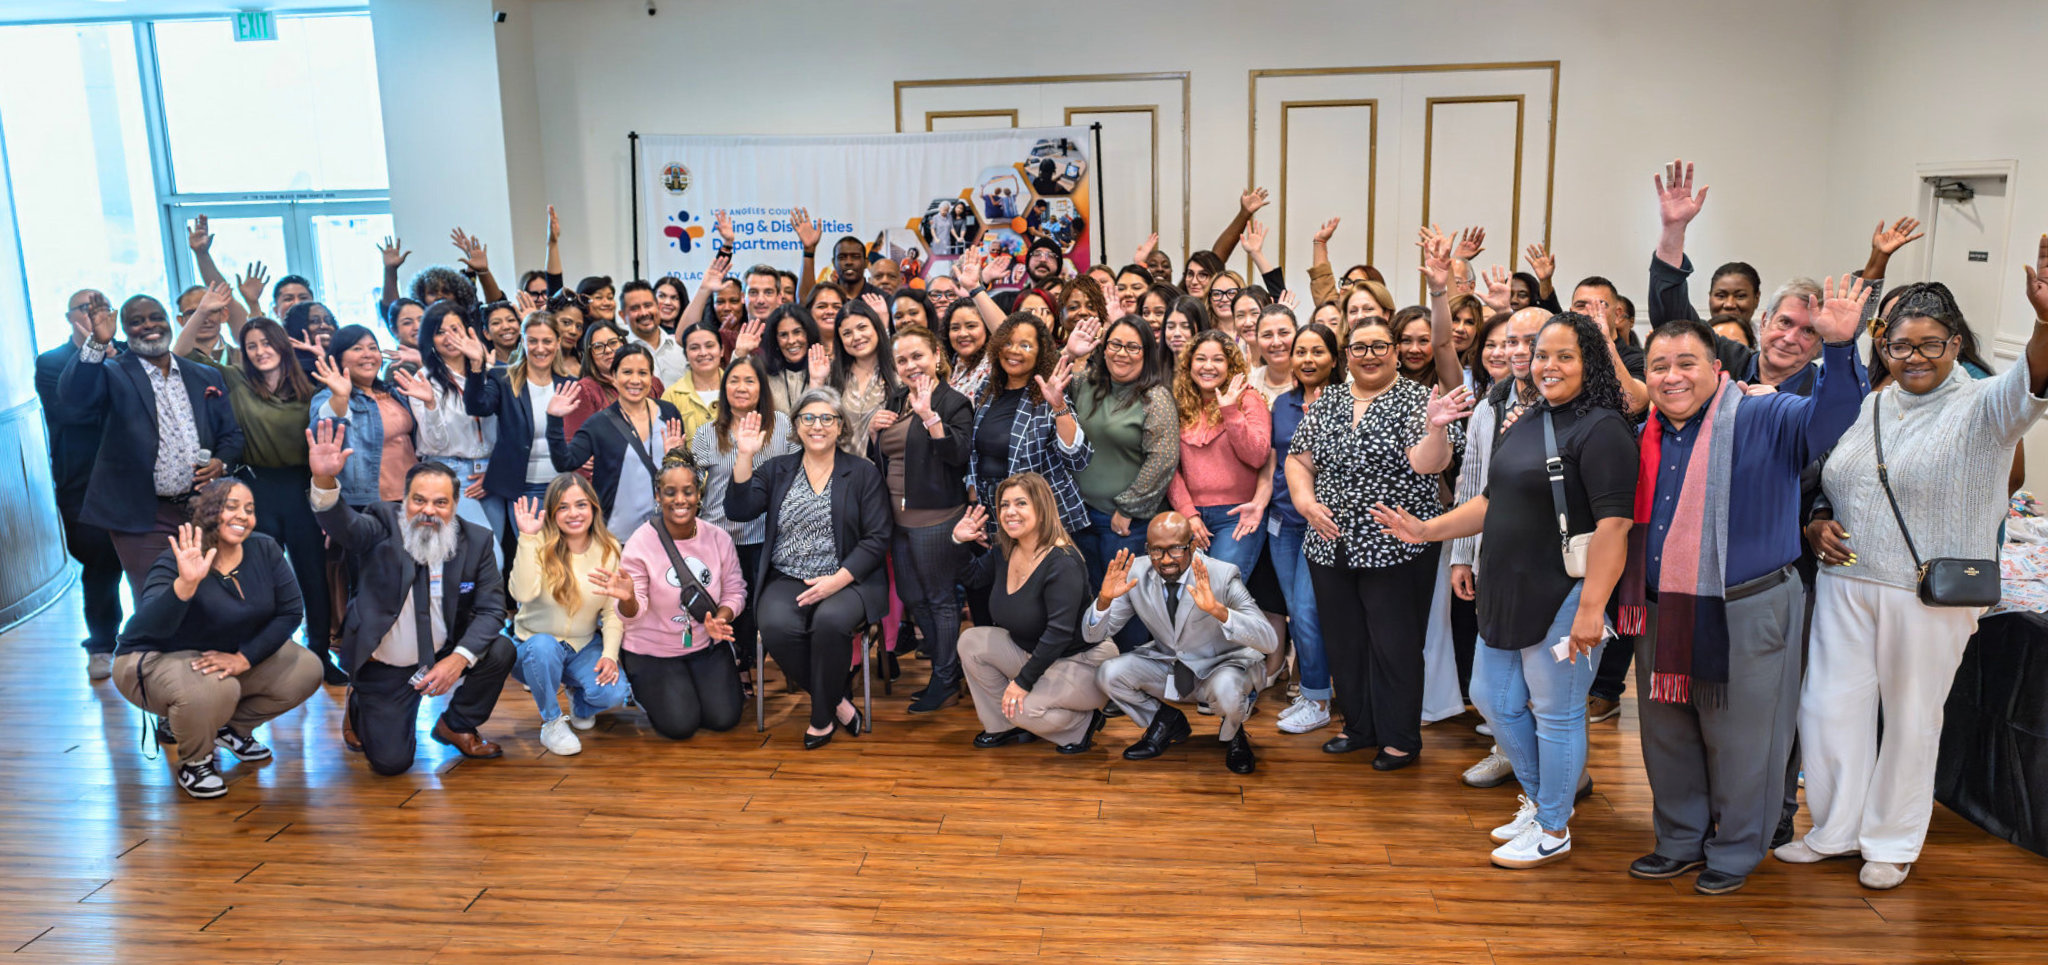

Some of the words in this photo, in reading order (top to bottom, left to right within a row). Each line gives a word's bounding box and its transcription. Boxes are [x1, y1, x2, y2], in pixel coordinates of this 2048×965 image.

[237, 12, 268, 39] EXIT
[729, 207, 766, 216] ANGELES
[711, 220, 754, 235] Aing
[757, 220, 768, 233] &
[771, 219, 853, 233] Disiities
[712, 238, 804, 254] Dpartment
